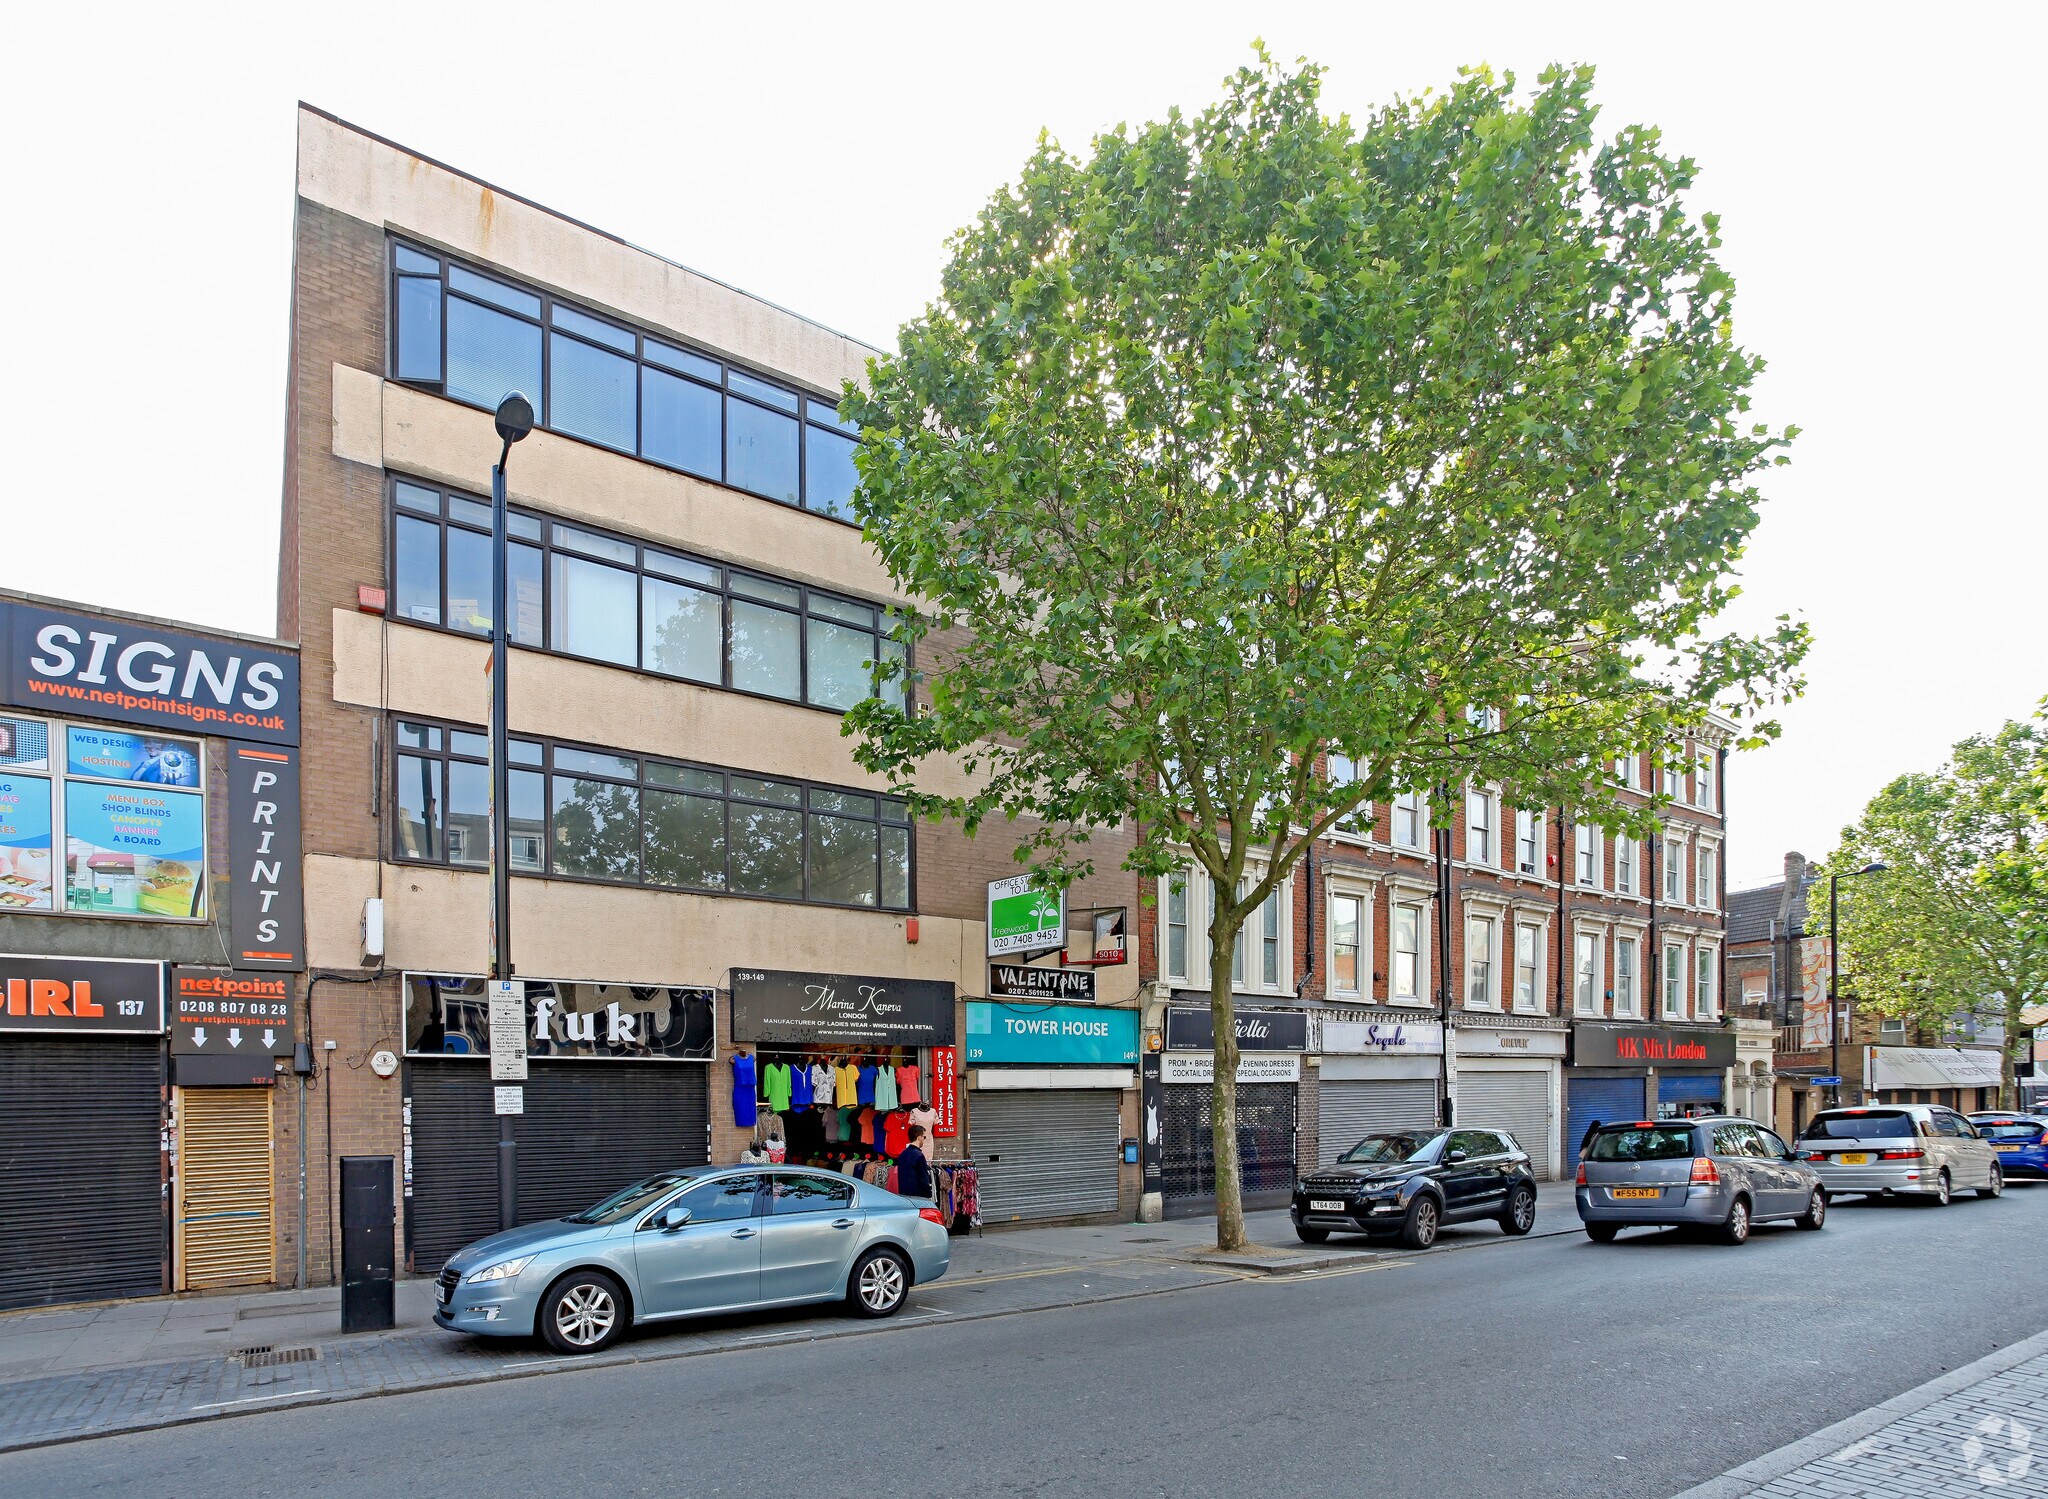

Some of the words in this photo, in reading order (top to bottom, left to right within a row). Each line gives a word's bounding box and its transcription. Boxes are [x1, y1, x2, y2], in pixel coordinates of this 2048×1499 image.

[30, 624, 284, 711] SIGNS
[28, 679, 285, 731] www.netpointsigns.co.uk
[74, 734, 98, 745] WEB
[102, 738, 141, 749] DESIGN
[82, 756, 132, 768] HOSTING
[107, 794, 139, 804] MENU
[142, 798, 165, 807] BOX
[102, 803, 132, 813] SHOP
[135, 807, 171, 817] BLINDS
[110, 815, 163, 827] CANOPYS
[114, 825, 159, 836] BANNER
[124, 837, 162, 846] BOARD
[250, 771, 282, 943] PRINTS
[994, 878, 1019, 890] OFFICE
[1010, 885, 1021, 895] TO
[993, 922, 1029, 935] Treewood
[994, 937, 1008, 948] 020
[1013, 933, 1033, 944] 7408
[1036, 929, 1058, 940] 9452
[1117, 936, 1123, 948] T
[738, 973, 765, 981] 139-149
[999, 967, 1089, 991] VALENTINE
[180, 977, 286, 997] netpoint
[1008, 987, 1054, 997] 0207.5611125
[801, 985, 855, 1012] Marina
[858, 985, 902, 1015] Kaneva
[117, 1000, 144, 1016] 137
[180, 1001, 215, 1012] 0208
[220, 1002, 246, 1013] 807
[250, 1003, 266, 1015] 08
[271, 1004, 287, 1015] 28
[180, 1016, 287, 1026] www.netpointsigns.co.uk
[534, 998, 636, 1042] fuk
[763, 1018, 816, 1026] MANUFACTURER
[838, 1012, 868, 1020] LONDON
[1005, 1018, 1059, 1035] TOWER
[1062, 1021, 1109, 1036] HOUSE
[1498, 1036, 1529, 1048] OREVER
[1617, 1037, 1640, 1058] MK
[1642, 1037, 1664, 1058] Mix
[1667, 1039, 1706, 1059] London
[970, 1049, 982, 1058] 139
[946, 1051, 954, 1126] AVAILABLE
